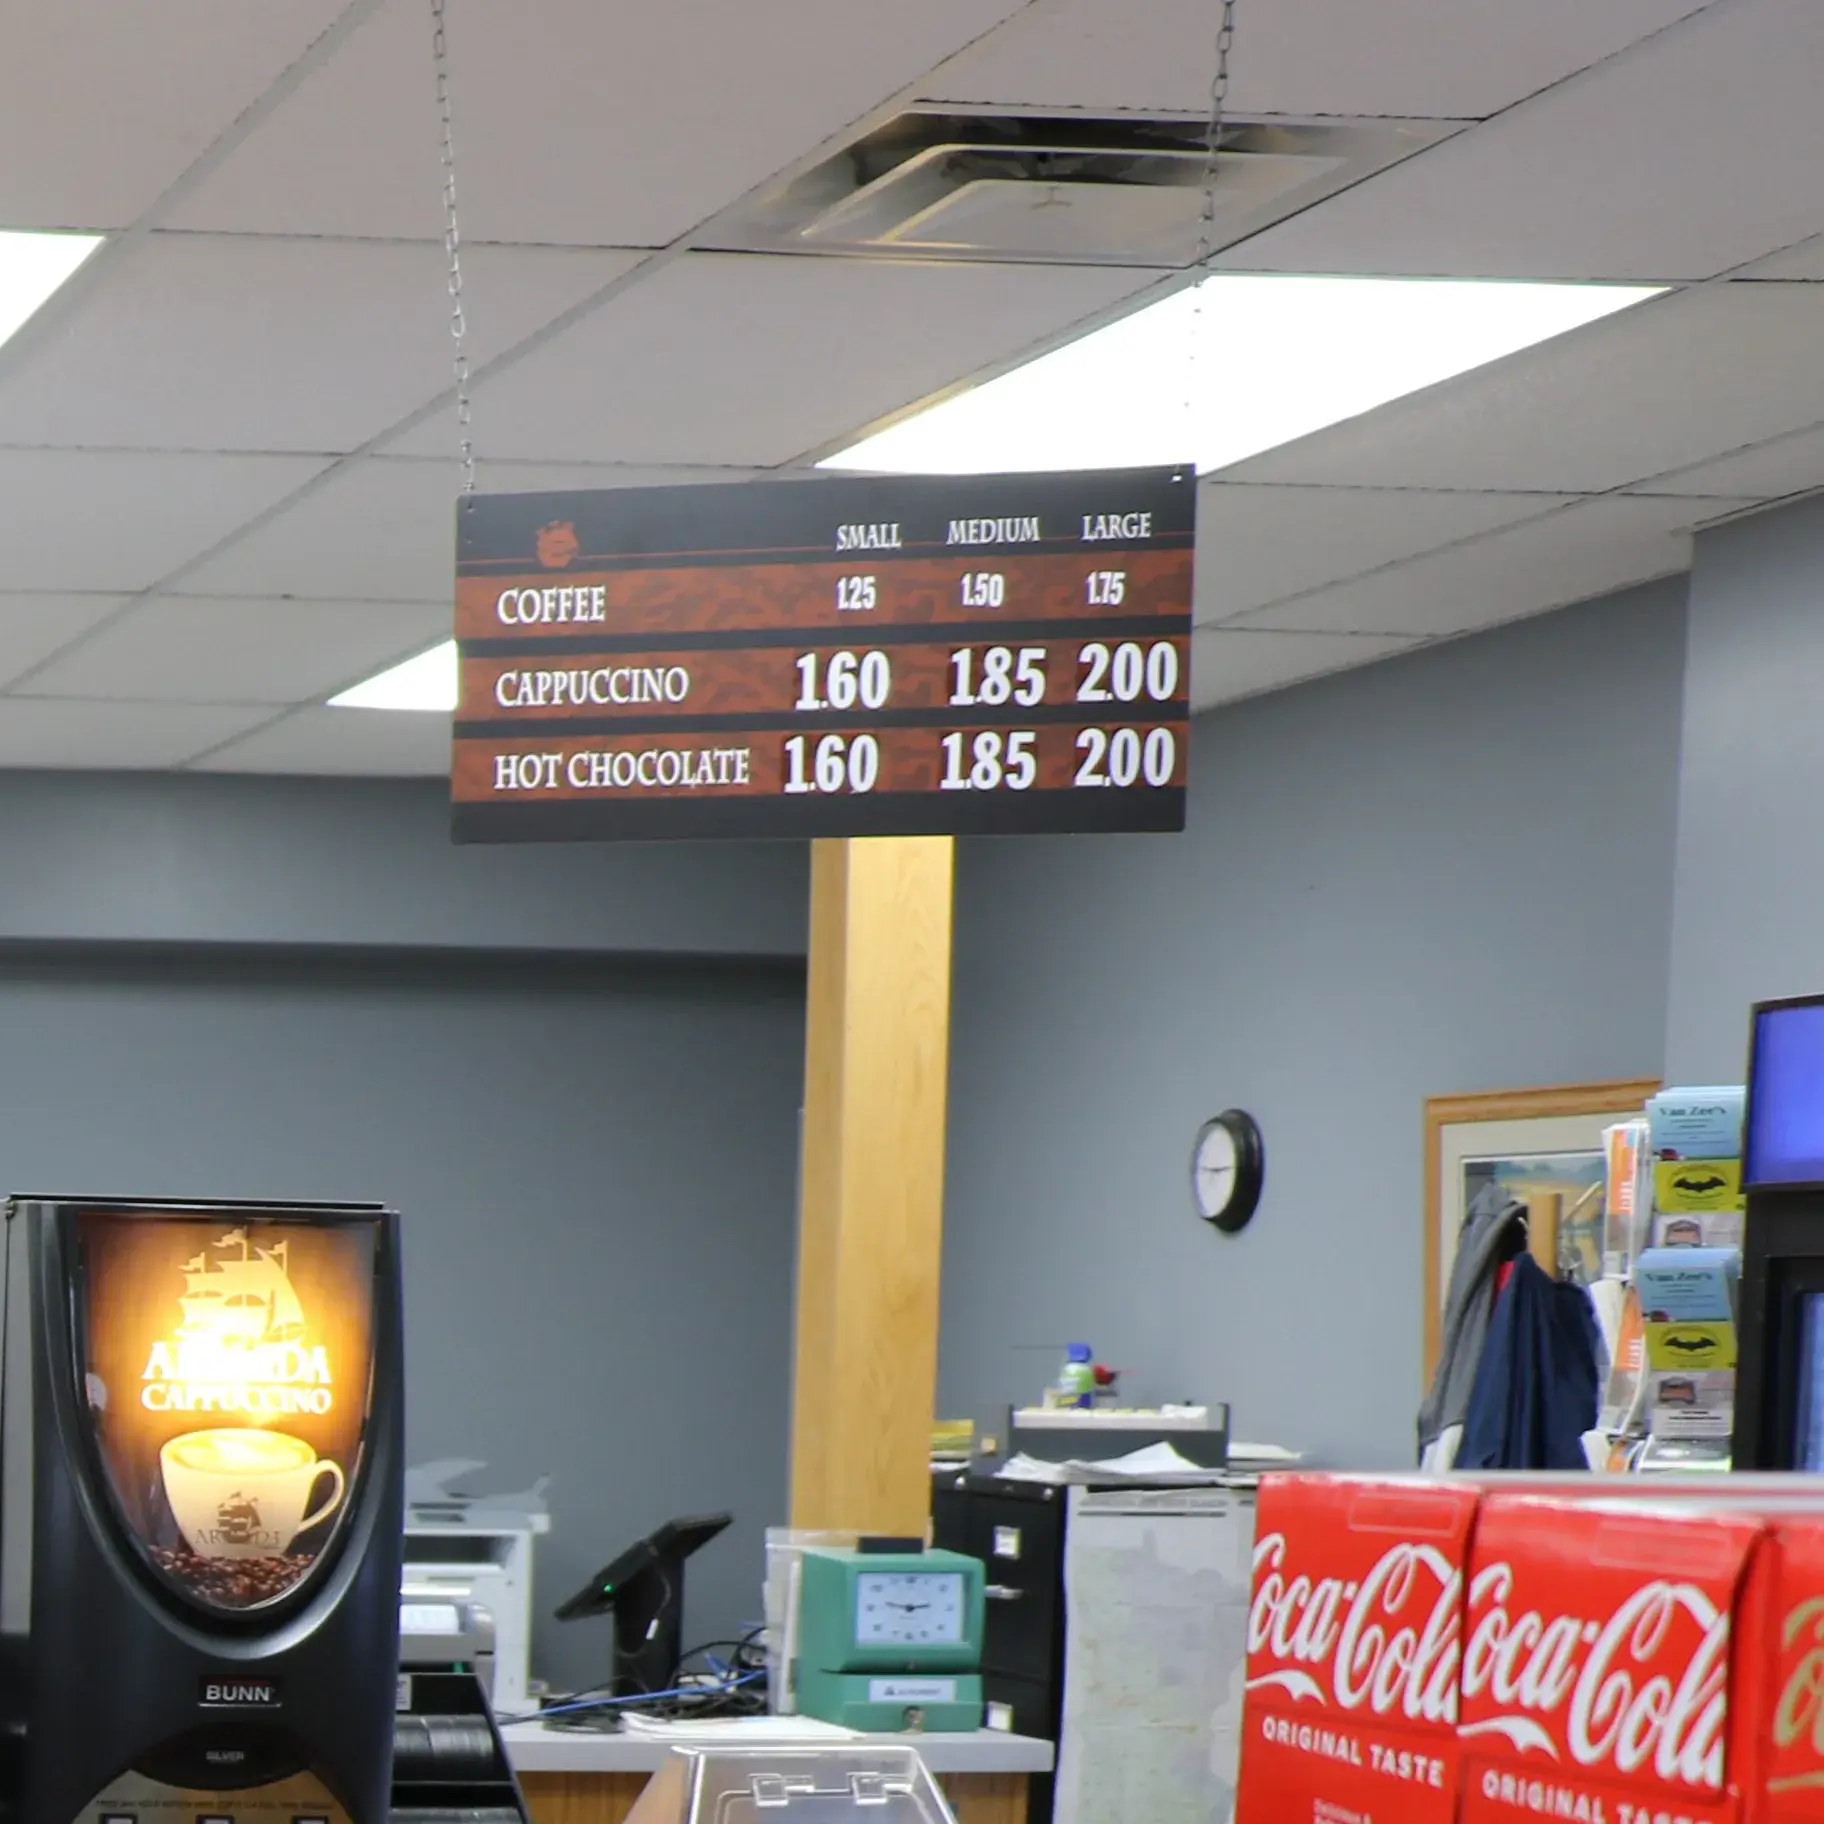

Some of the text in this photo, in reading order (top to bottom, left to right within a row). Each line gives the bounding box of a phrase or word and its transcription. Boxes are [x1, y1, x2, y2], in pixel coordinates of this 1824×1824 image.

[836, 512, 1151, 551] SMALL MEDIUM LARGE
[497, 586, 606, 625] COFFEE
[496, 641, 1179, 711] CAPPUCCINO 1.60 1.85 2.00
[493, 726, 1175, 794] HOT CHOCOLATE 1.60 1.85 2.00
[141, 1341, 332, 1384] ADA
[141, 1383, 333, 1415] CAPPUCCINO
[195, 1528, 281, 1545] ARDA
[206, 1685, 271, 1702] BUNN
[1460, 1562, 1730, 1789] Coca-Cola
[206, 1751, 244, 1761] SILVER
[1263, 1715, 1445, 1788] ORIGINAL TASTE
